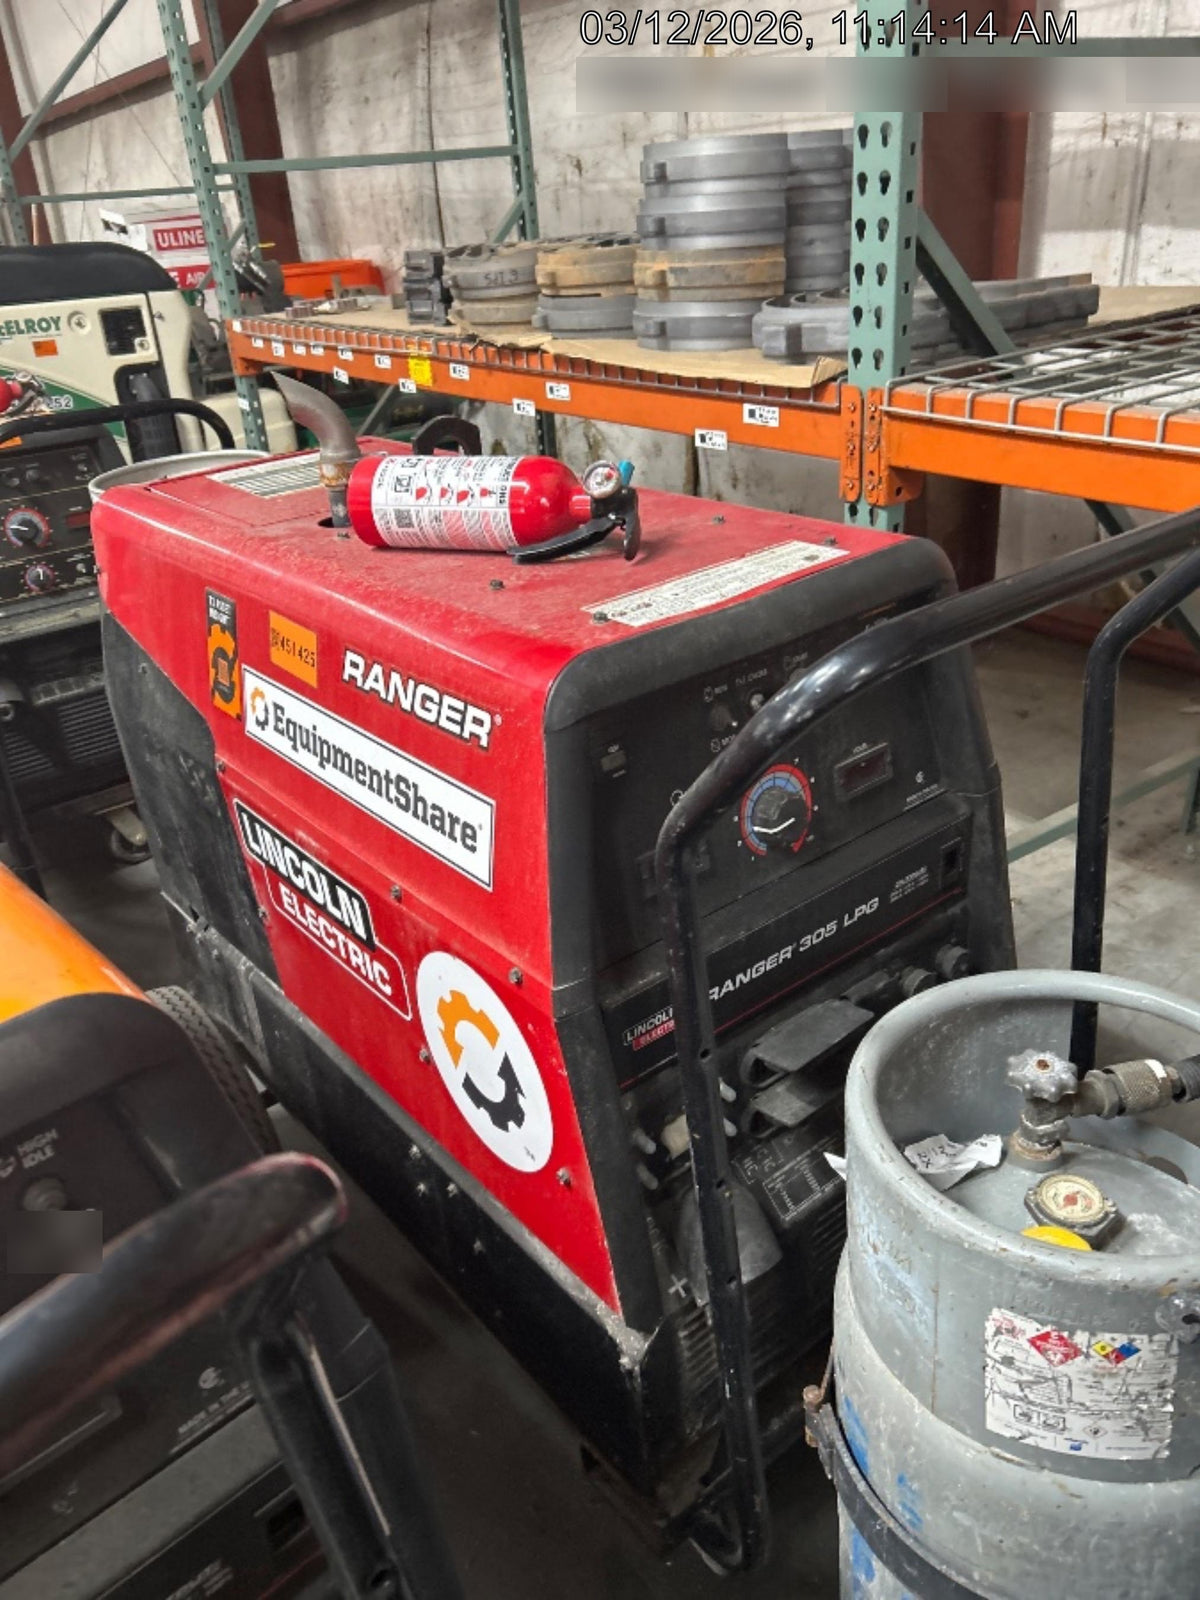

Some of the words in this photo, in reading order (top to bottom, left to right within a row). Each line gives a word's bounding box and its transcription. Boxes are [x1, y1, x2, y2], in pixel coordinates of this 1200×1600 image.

[156, 229, 205, 248] ULINE
[0, 316, 61, 337] ELROY
[272, 700, 479, 854] EquipmentShare
[241, 811, 367, 941] LINCOLN
[278, 881, 393, 996] ELECTRIC
[799, 920, 839, 952] 305
[843, 896, 880, 929] LPG
